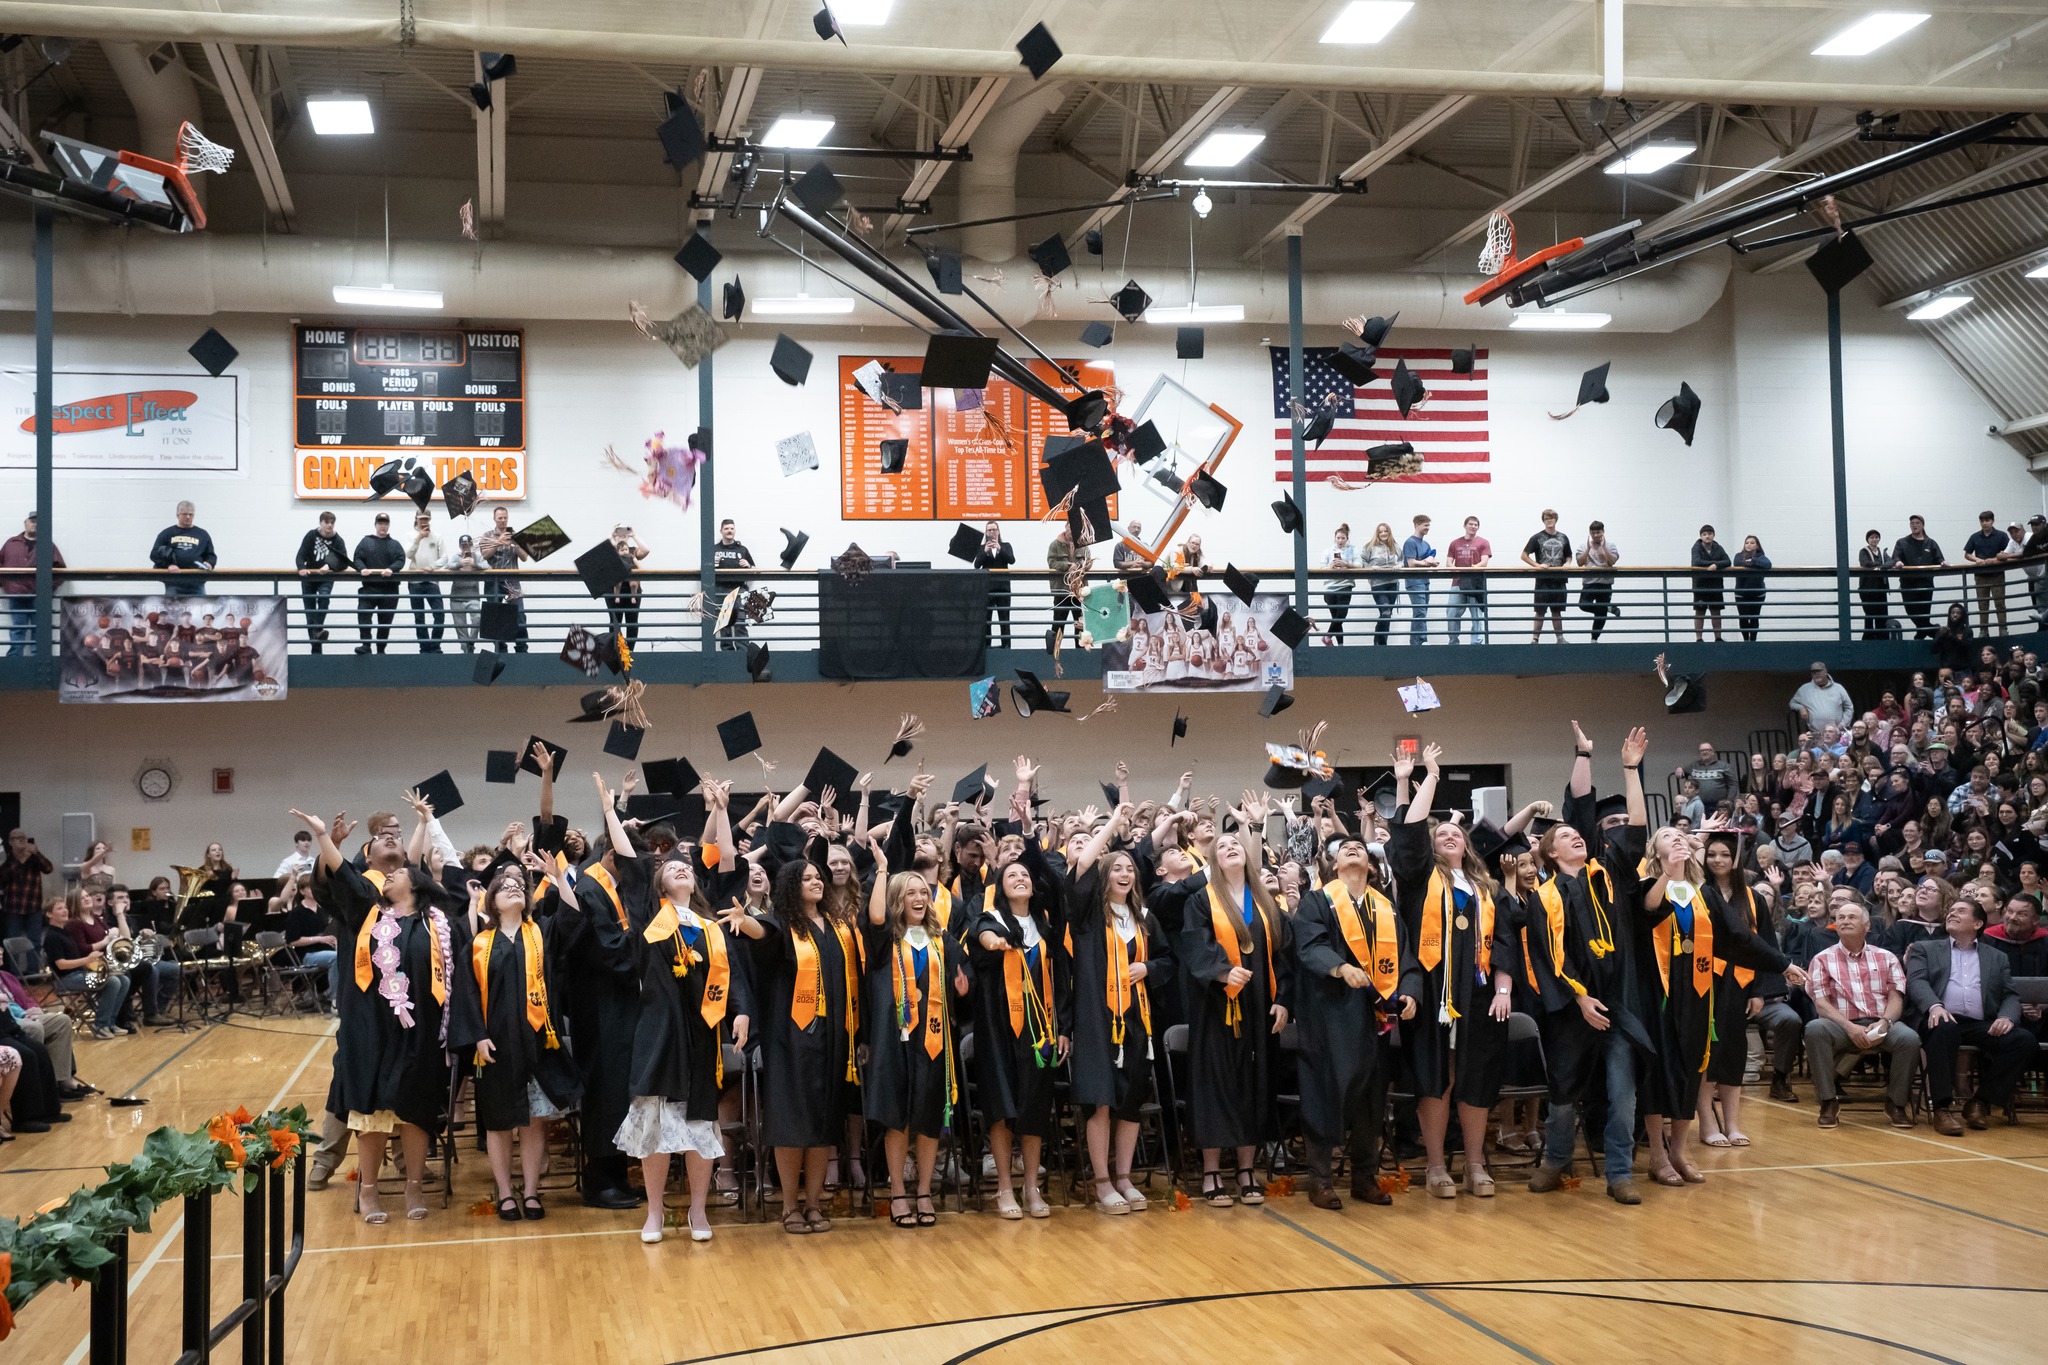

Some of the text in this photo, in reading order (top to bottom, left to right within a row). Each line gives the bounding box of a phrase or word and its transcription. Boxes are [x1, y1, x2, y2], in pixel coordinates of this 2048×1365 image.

[305, 330, 520, 348] HOME VISITOR
[390, 368, 410, 377] POSS
[322, 382, 356, 393] BONUS
[382, 377, 418, 388] PERIOD
[465, 384, 498, 395] BONUS
[315, 400, 348, 410] FOULS
[378, 401, 454, 412] PLAYER FOULS
[475, 402, 506, 412] FOULS
[15, 407, 32, 416] THE
[126, 393, 187, 437] Effect
[320, 436, 342, 444] WON
[399, 436, 426, 445] GAME
[480, 437, 501, 447] WON
[954, 446, 965, 455] Top
[975, 446, 996, 454] All-Time
[714, 551, 737, 559] POLICE
[74, 602, 276, 616] GRANT TIGERS
[1422, 939, 1440, 947] 2025
[356, 960, 369, 969] 2025
[796, 995, 815, 1004] 2025
[1010, 1004, 1023, 1012] 2025
